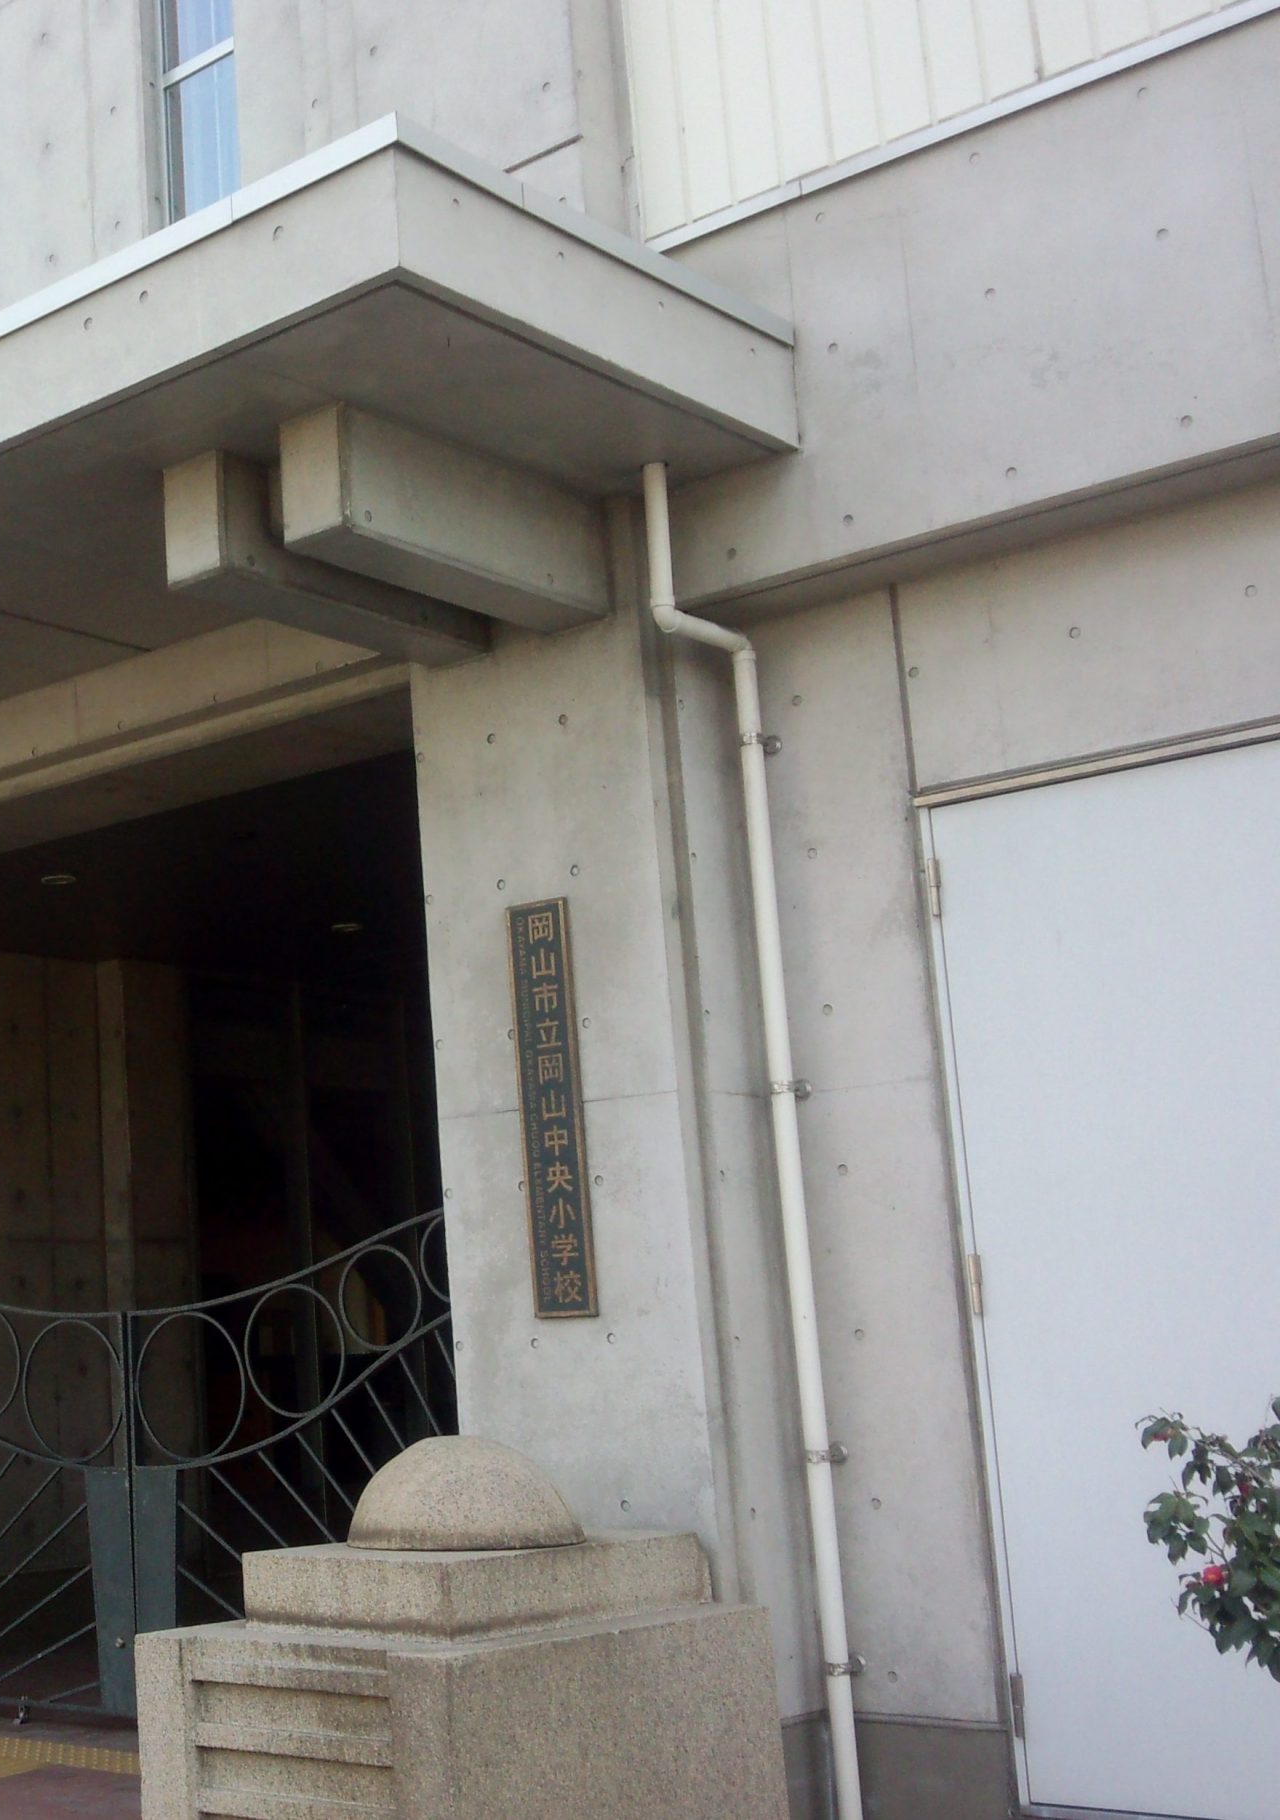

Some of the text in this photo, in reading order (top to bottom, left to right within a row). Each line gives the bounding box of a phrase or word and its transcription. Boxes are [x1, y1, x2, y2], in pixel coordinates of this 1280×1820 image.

[527, 912, 582, 1303] 岡山市立岡山中央小学校
[539, 1249, 552, 1303] SCHOOL
